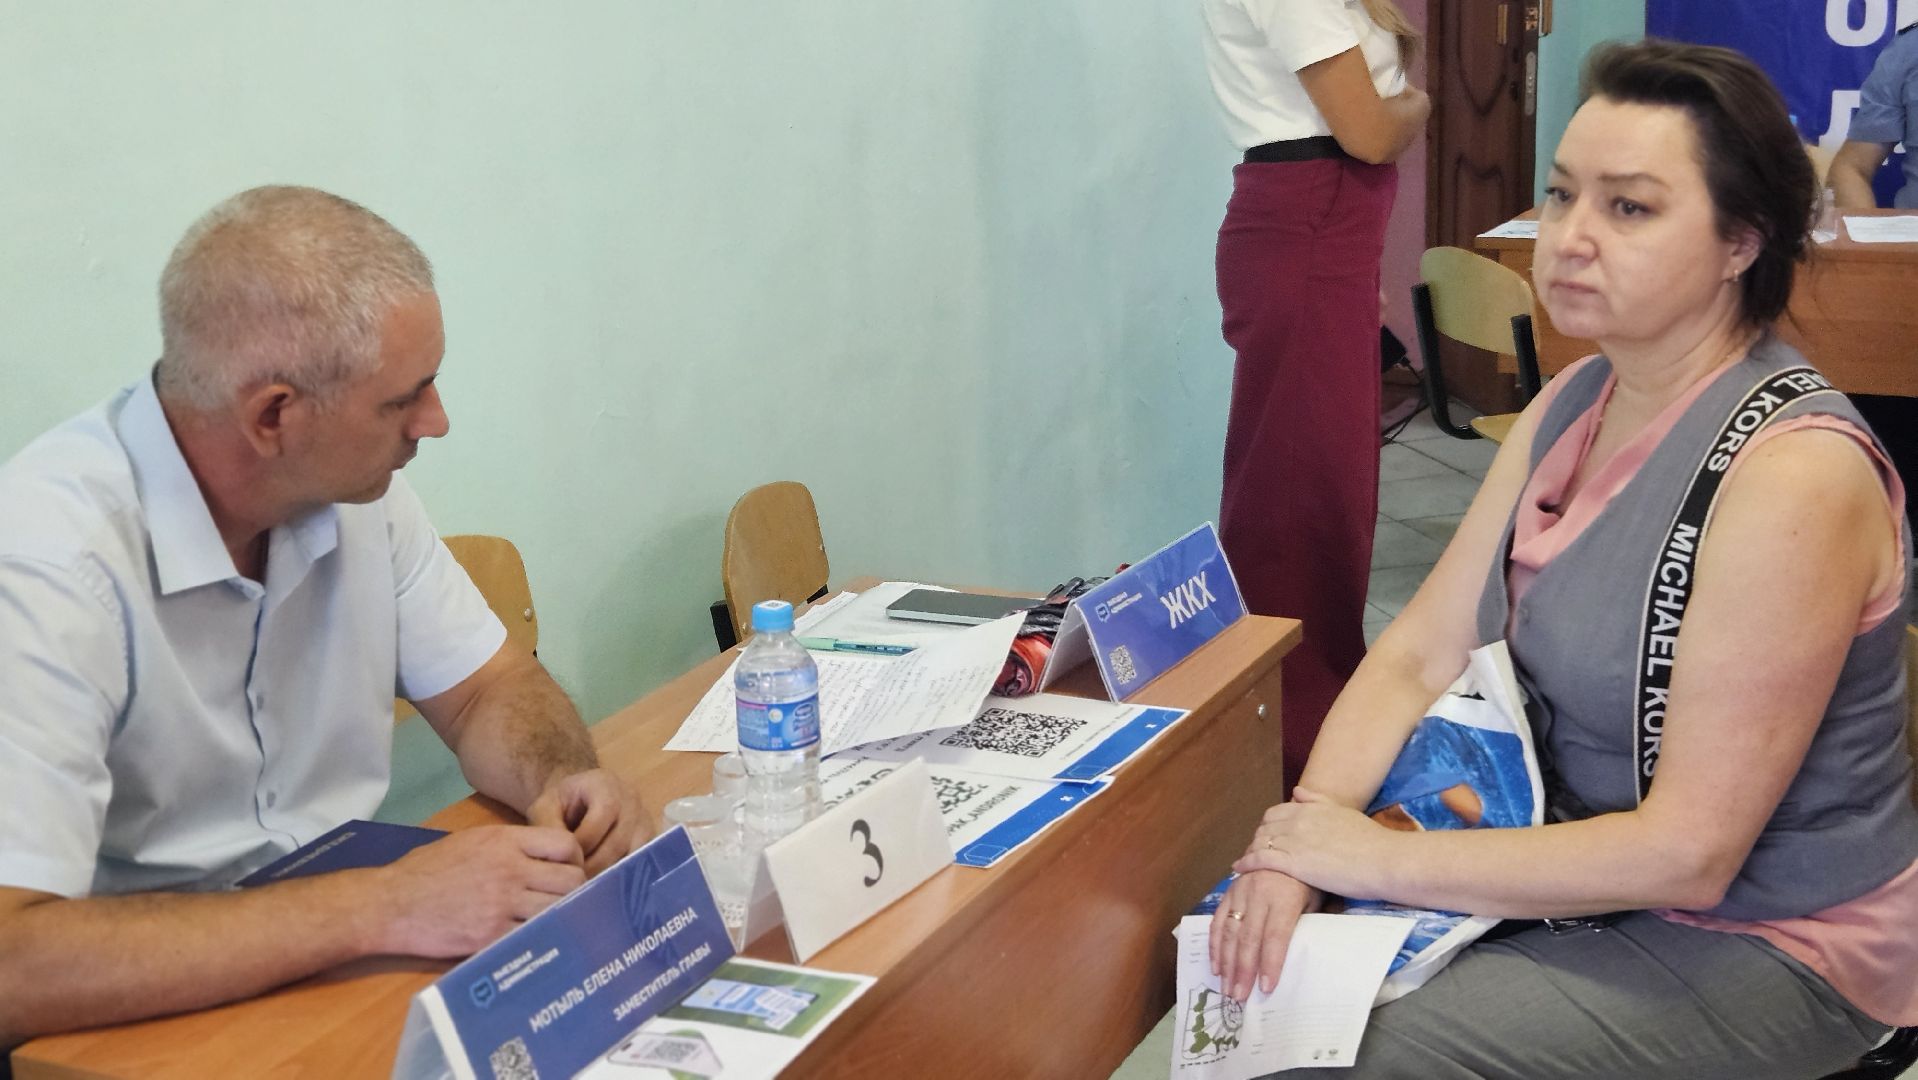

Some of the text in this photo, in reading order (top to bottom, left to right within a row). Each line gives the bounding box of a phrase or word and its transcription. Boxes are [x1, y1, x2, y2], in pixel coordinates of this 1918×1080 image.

[1707, 391, 1783, 472] KORS
[1159, 570, 1217, 630] ЖКХ
[1646, 522, 1698, 677] MICHAEL
[849, 818, 884, 888] 3
[529, 906, 698, 1034] МОТЫЛЬ ЕЛЕНА НИКОЛАЕВНА
[613, 942, 711, 1021] ЗАМЕСТИТЕЛЬ ГЛАВЫ
